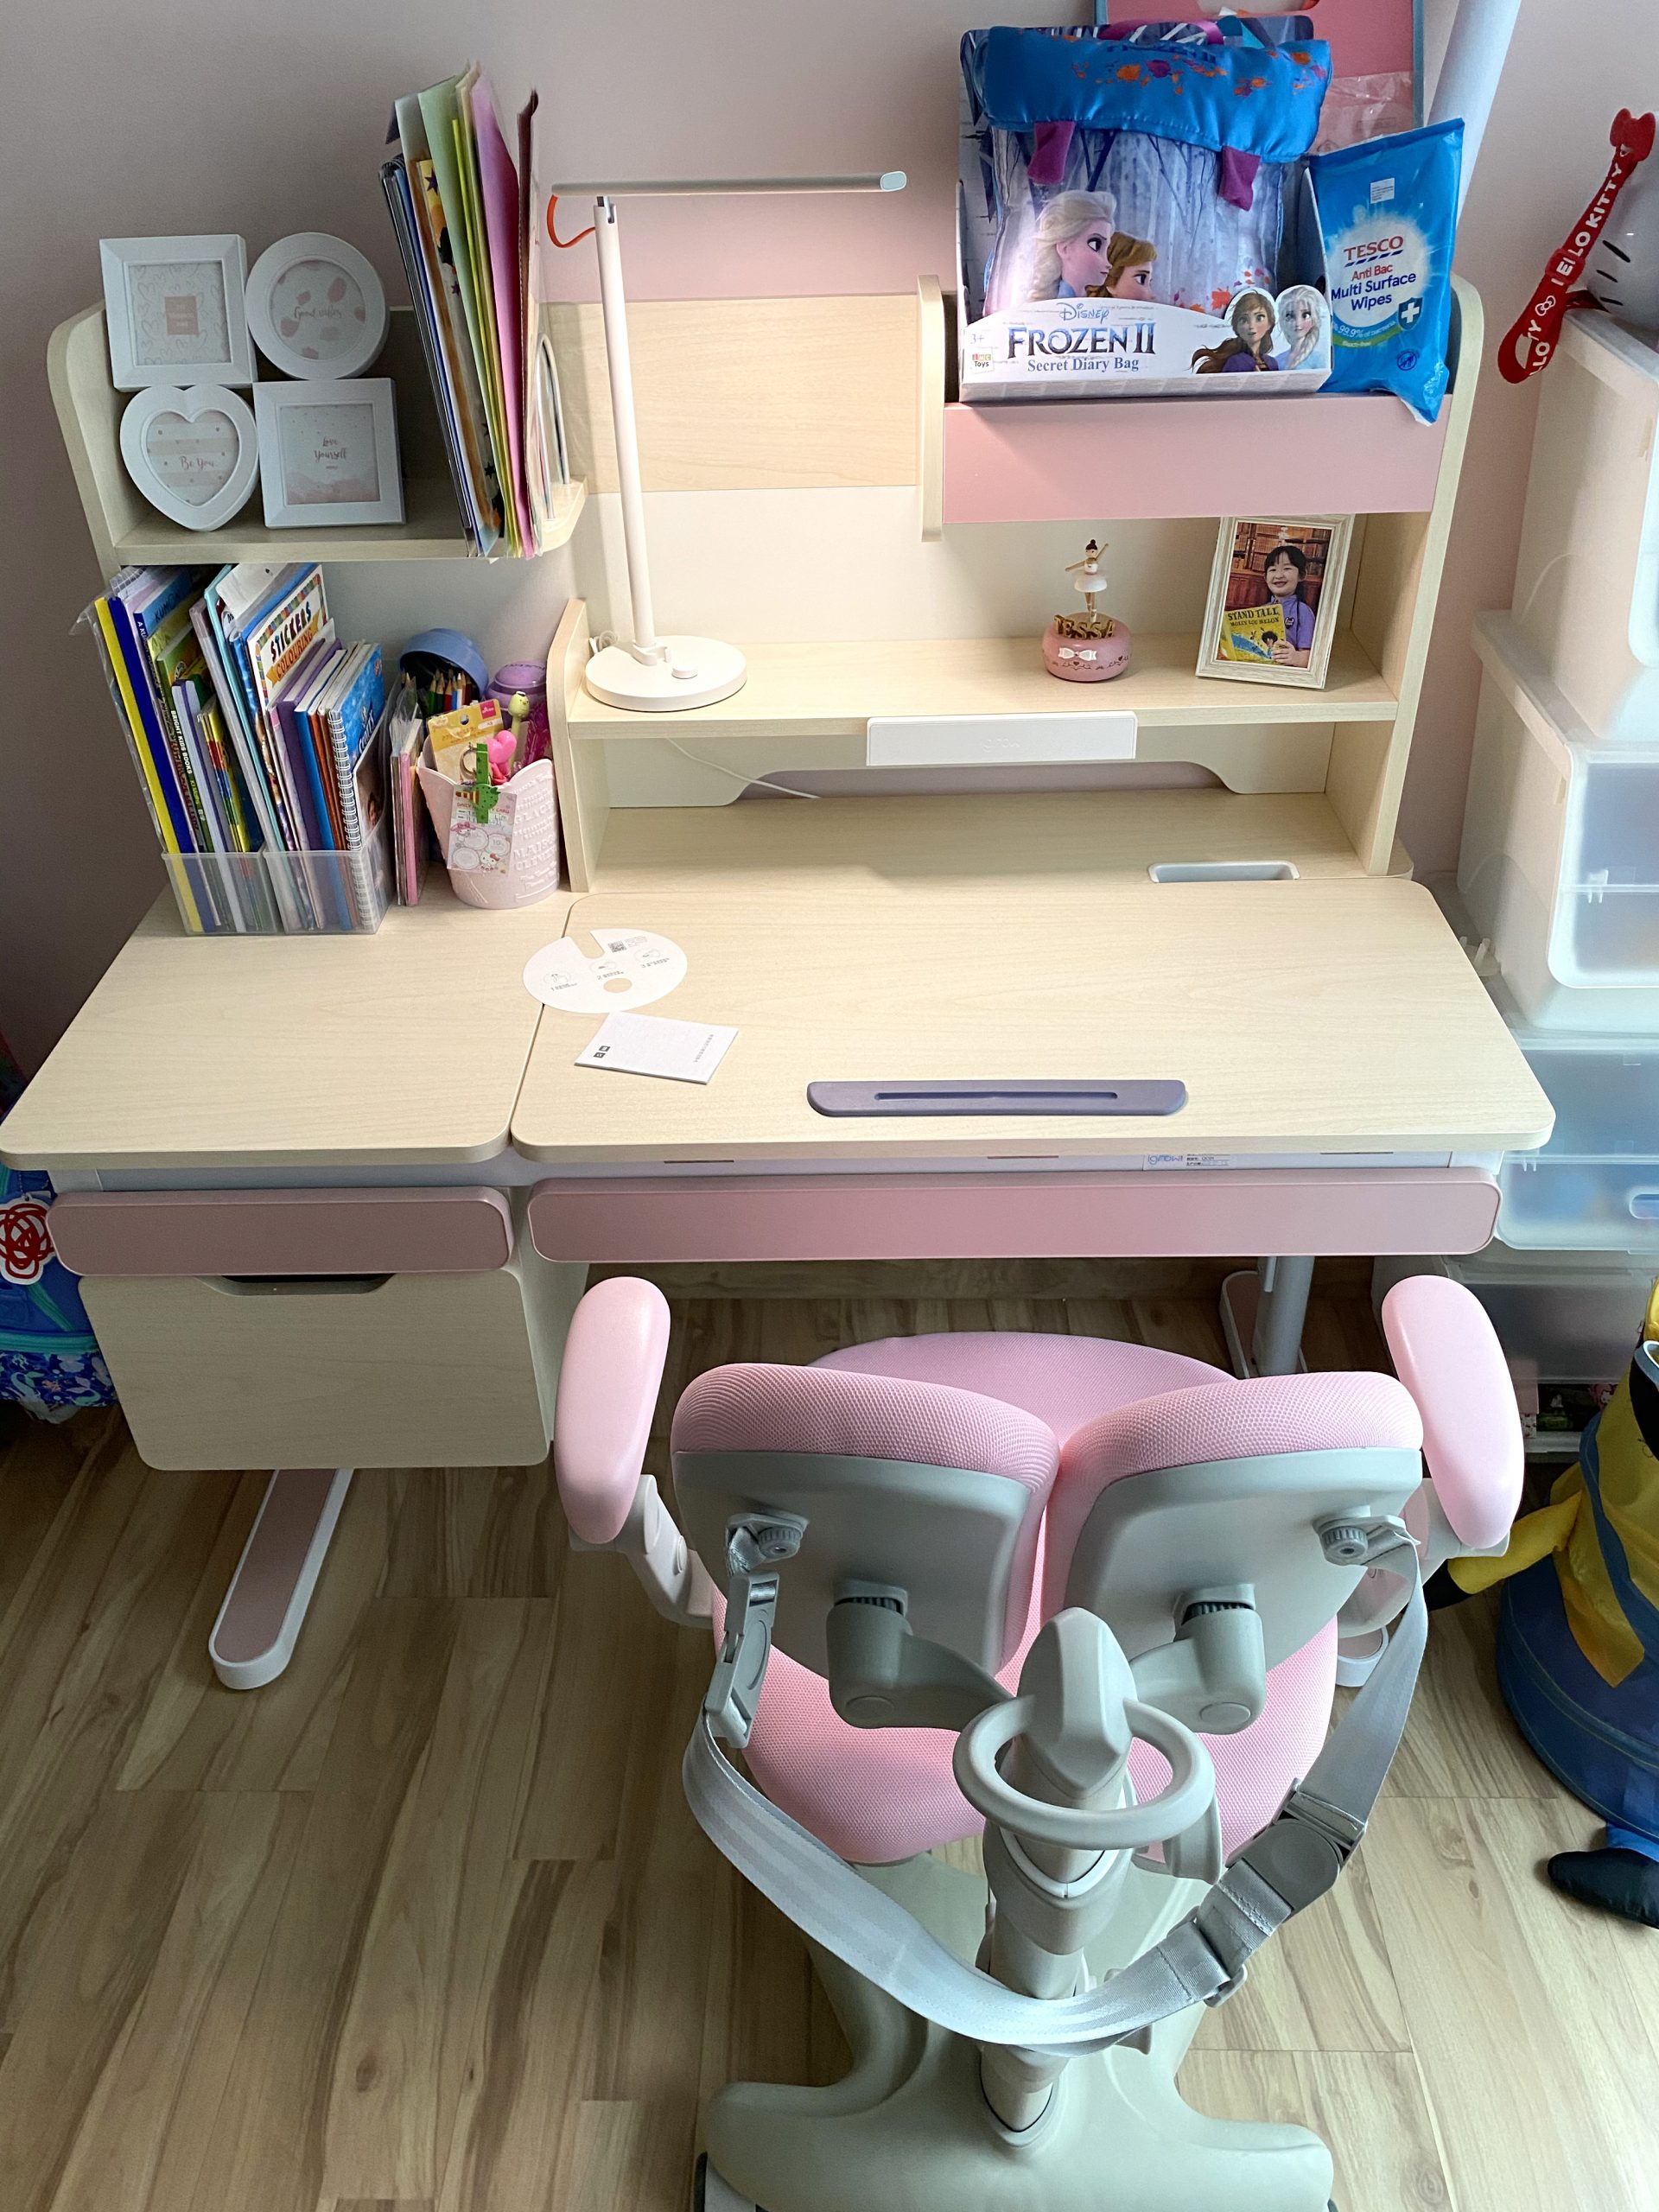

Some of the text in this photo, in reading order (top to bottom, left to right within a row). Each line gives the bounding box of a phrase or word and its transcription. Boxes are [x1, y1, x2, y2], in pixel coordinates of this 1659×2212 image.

[1344, 236, 1404, 261] TESCO
[1351, 264, 1394, 281] Anti Bac
[1332, 272, 1416, 301] Multi Surface
[1056, 302, 1109, 324] Disney
[1351, 294, 1392, 311] Wipes
[1007, 321, 1156, 359] FROZEN II
[1027, 358, 1140, 372] Secret Diary Bag
[1228, 607, 1279, 620] STAND TALL
[270, 601, 312, 664] STICKERS
[1054, 614, 1115, 640] TESSA
[170, 710, 181, 738] BRIGHT
[182, 752, 192, 774] BOOKS
